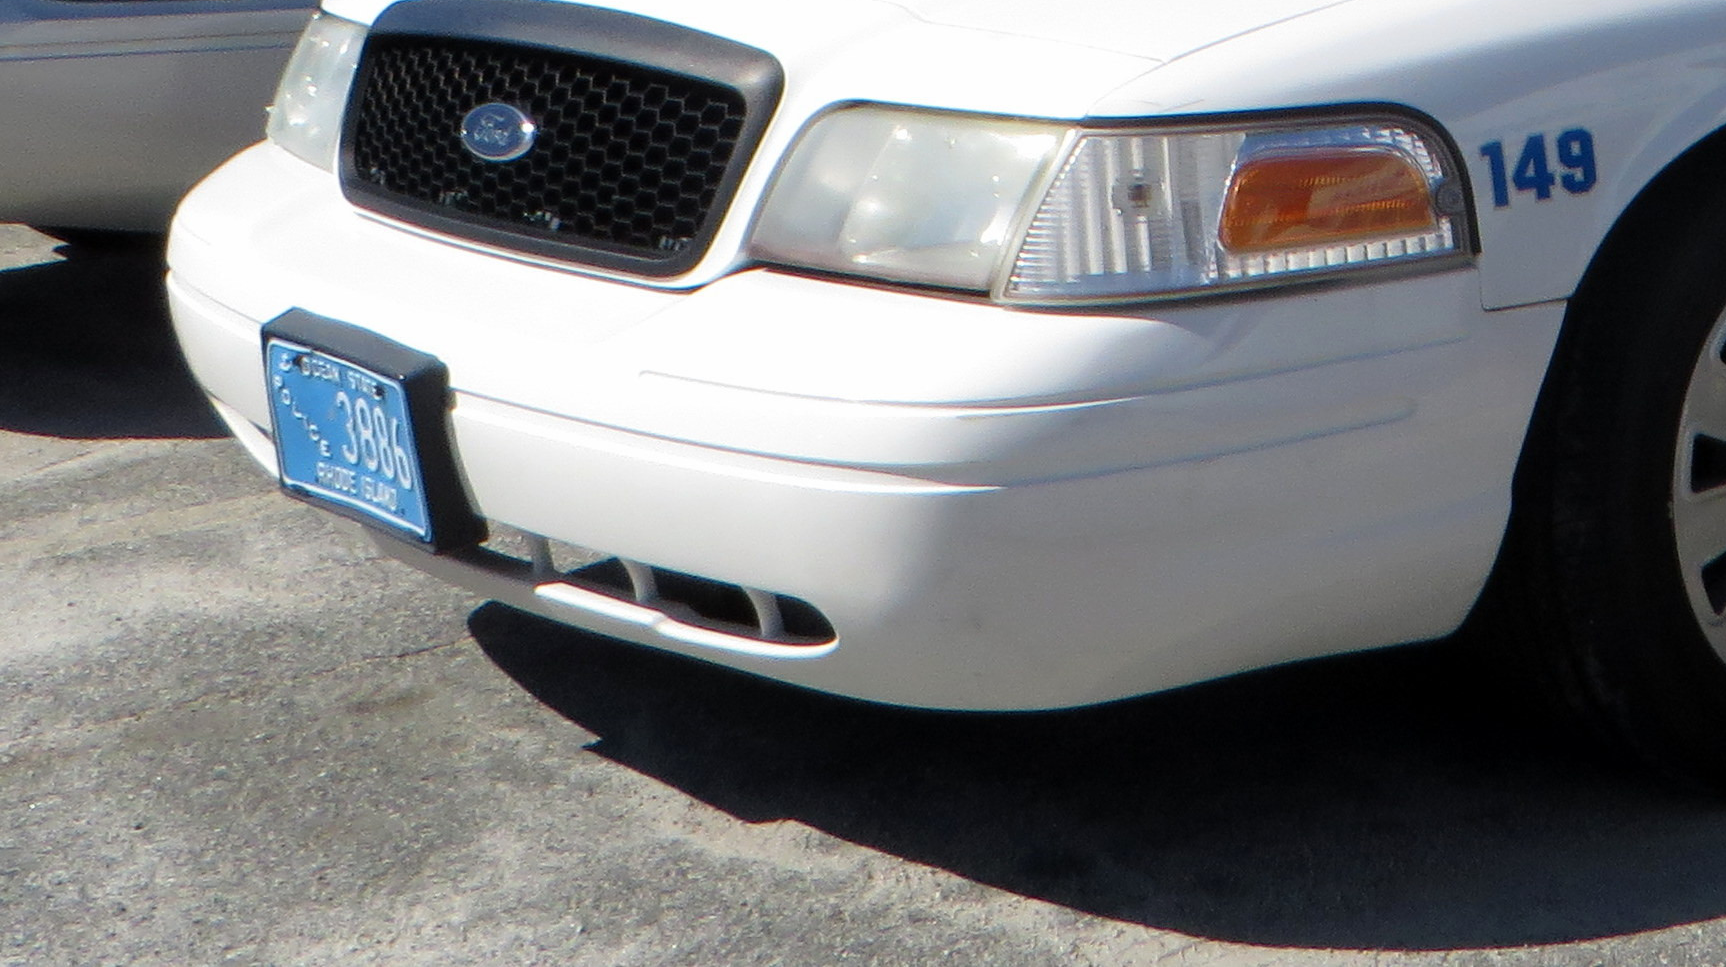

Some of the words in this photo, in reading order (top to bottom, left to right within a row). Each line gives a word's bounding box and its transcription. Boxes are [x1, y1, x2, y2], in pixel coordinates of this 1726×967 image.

[1480, 127, 1597, 208] 149
[336, 390, 412, 490] 3886
[316, 461, 357, 495] RHODE
[361, 475, 398, 511] ISLAND
